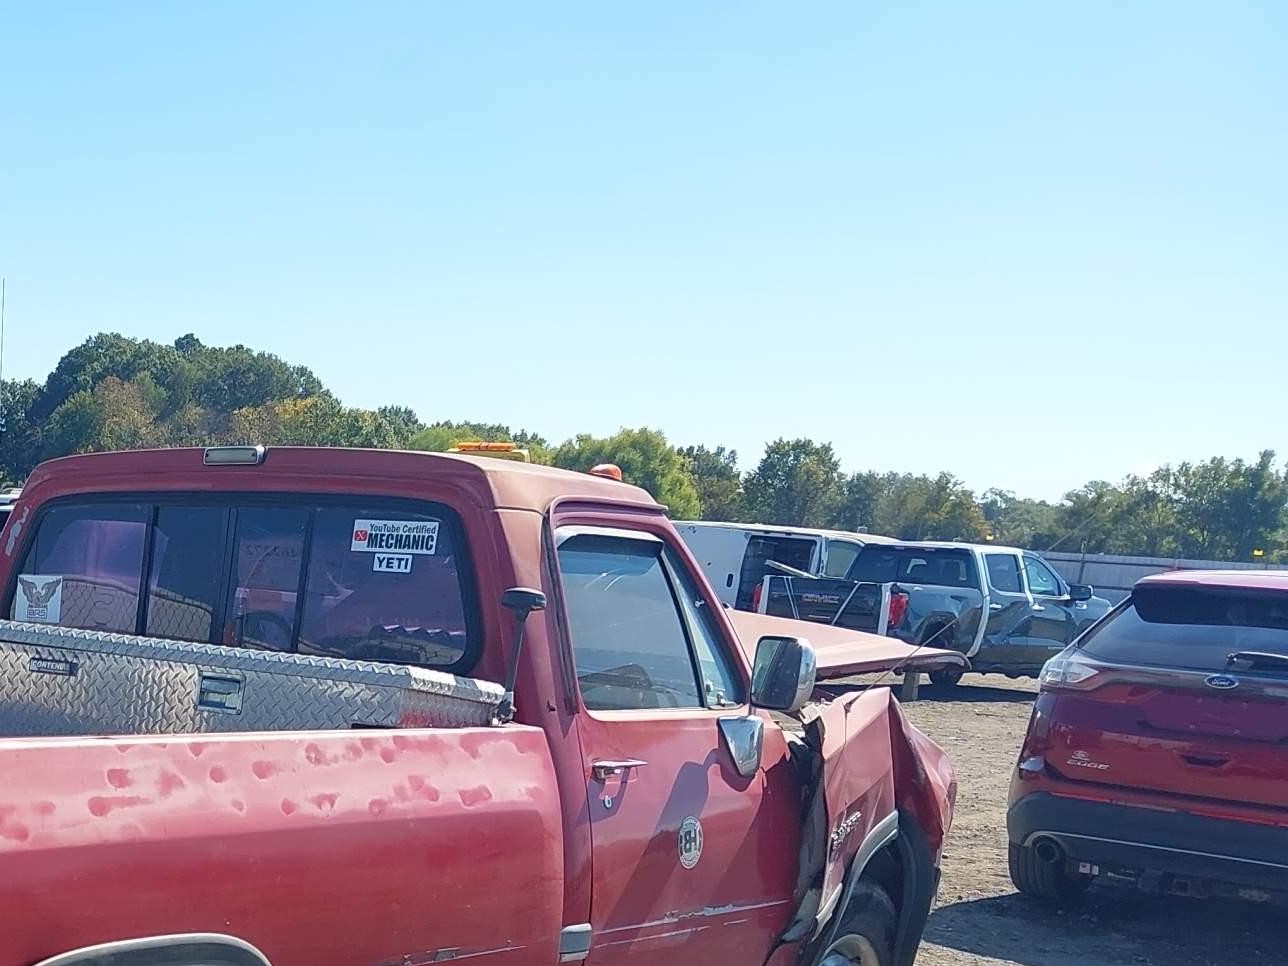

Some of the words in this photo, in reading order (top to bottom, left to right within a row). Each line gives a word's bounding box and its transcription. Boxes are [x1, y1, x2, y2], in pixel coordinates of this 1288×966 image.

[369, 523, 401, 533] YouTube
[402, 524, 436, 535] Certified
[367, 533, 435, 551] MECHANIC
[376, 556, 409, 570] YETI
[28, 608, 46, 617] BRS
[1066, 759, 1110, 770] EDGE
